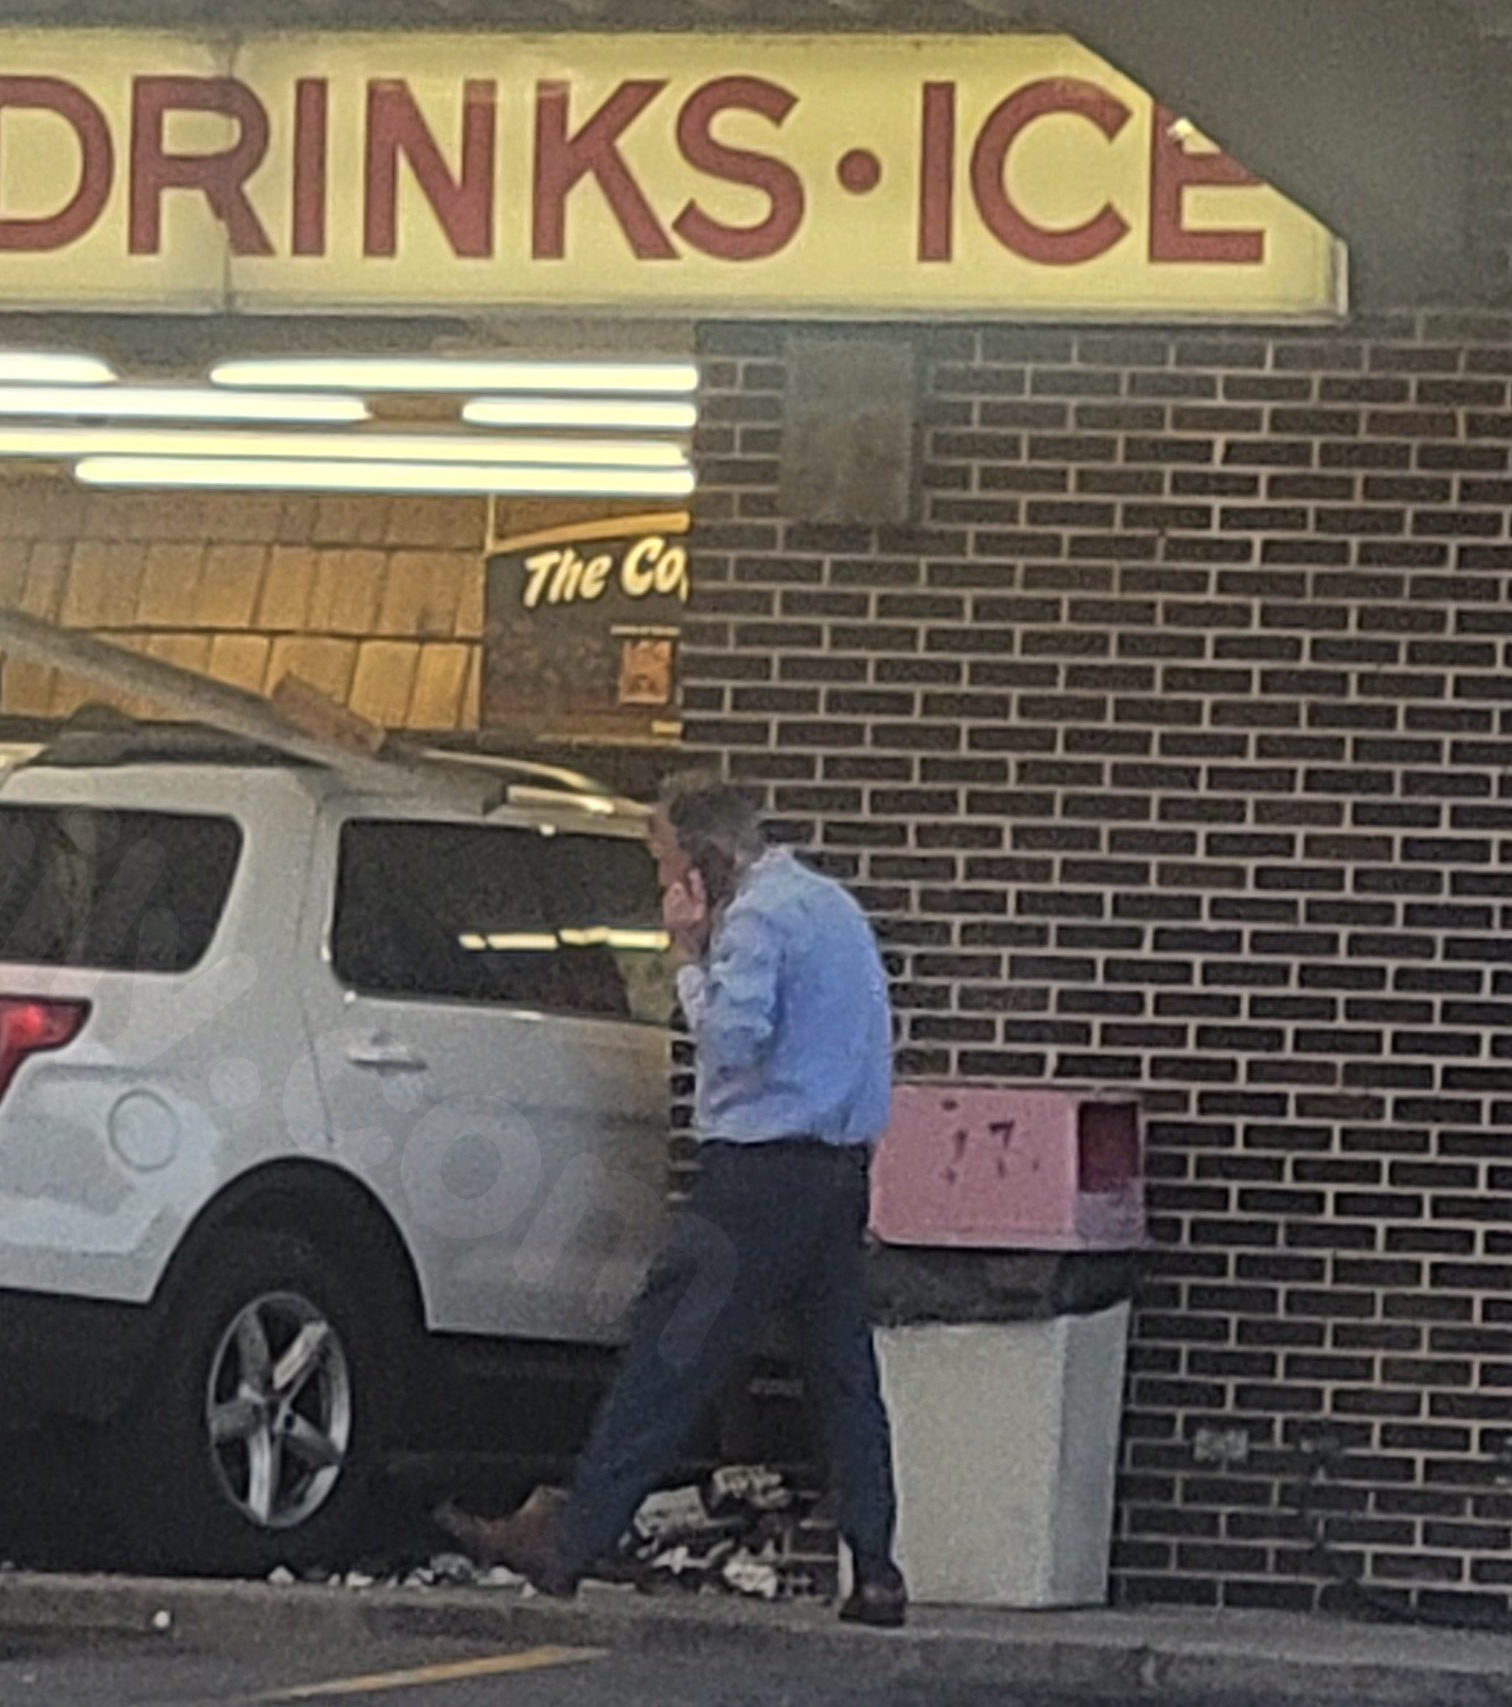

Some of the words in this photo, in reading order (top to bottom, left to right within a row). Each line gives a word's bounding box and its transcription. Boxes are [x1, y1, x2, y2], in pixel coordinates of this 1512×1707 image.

[917, 76, 1267, 266] ICE
[522, 548, 612, 608] The
[622, 536, 689, 603] Co
